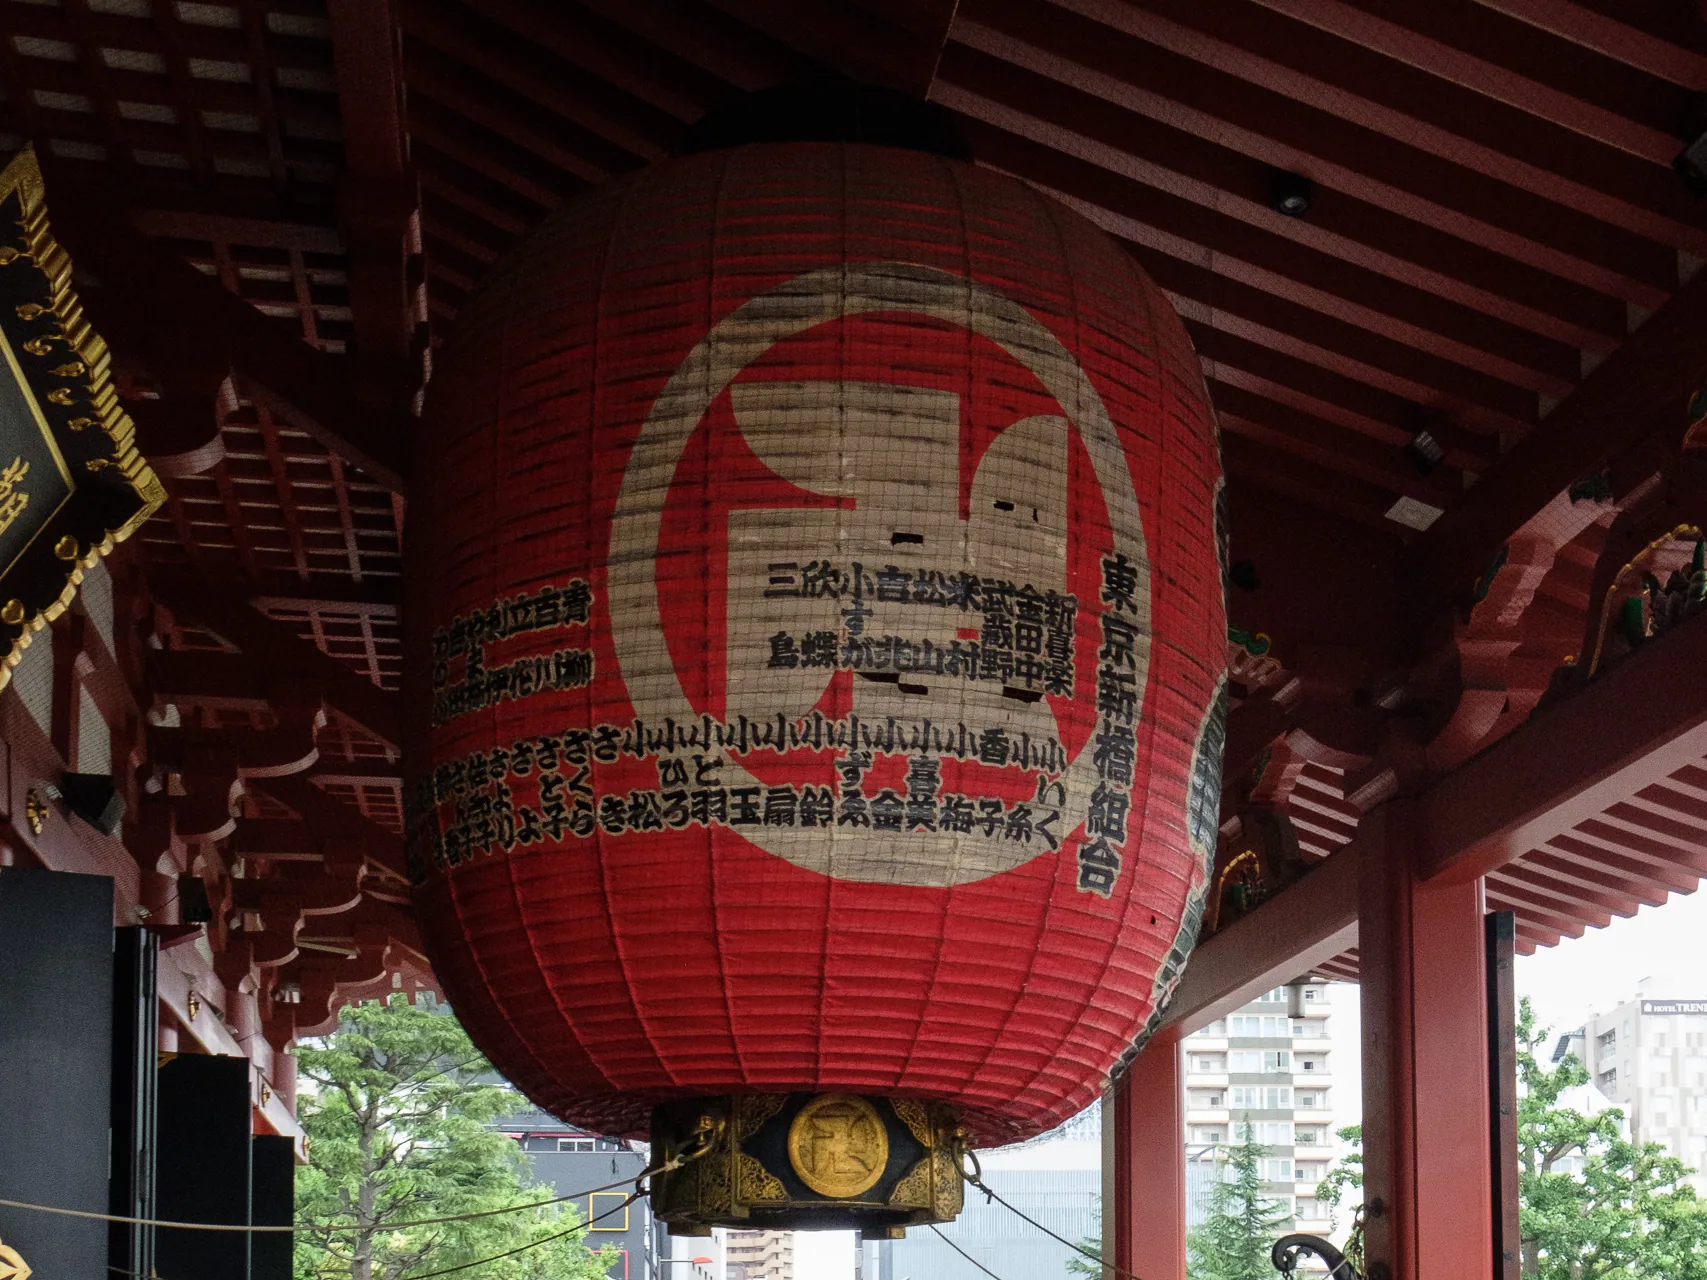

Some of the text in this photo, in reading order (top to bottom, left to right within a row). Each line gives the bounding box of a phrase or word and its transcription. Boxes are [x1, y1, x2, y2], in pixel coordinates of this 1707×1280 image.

[840, 561, 875, 669] 小すが
[911, 568, 952, 676] 松山
[979, 578, 1015, 684] 武蔵野
[1014, 583, 1046, 690] 金田中
[593, 726, 626, 833] さき
[623, 718, 664, 830] 小松
[646, 717, 692, 829] 小ひろ
[712, 714, 763, 825] 小玉
[750, 712, 798, 827] 小扇
[789, 712, 835, 827] 小鈴
[861, 715, 905, 831] 小金
[940, 722, 978, 834] 小梅
[1078, 552, 1141, 898] 東京新橋組合
[537, 737, 570, 841] さと子
[564, 730, 594, 835] さくら
[974, 728, 1011, 838] 香子
[1005, 732, 1034, 843] 小糸
[1033, 736, 1067, 852] 小いく
[1653, 1005, 1676, 1013] HOTEL
